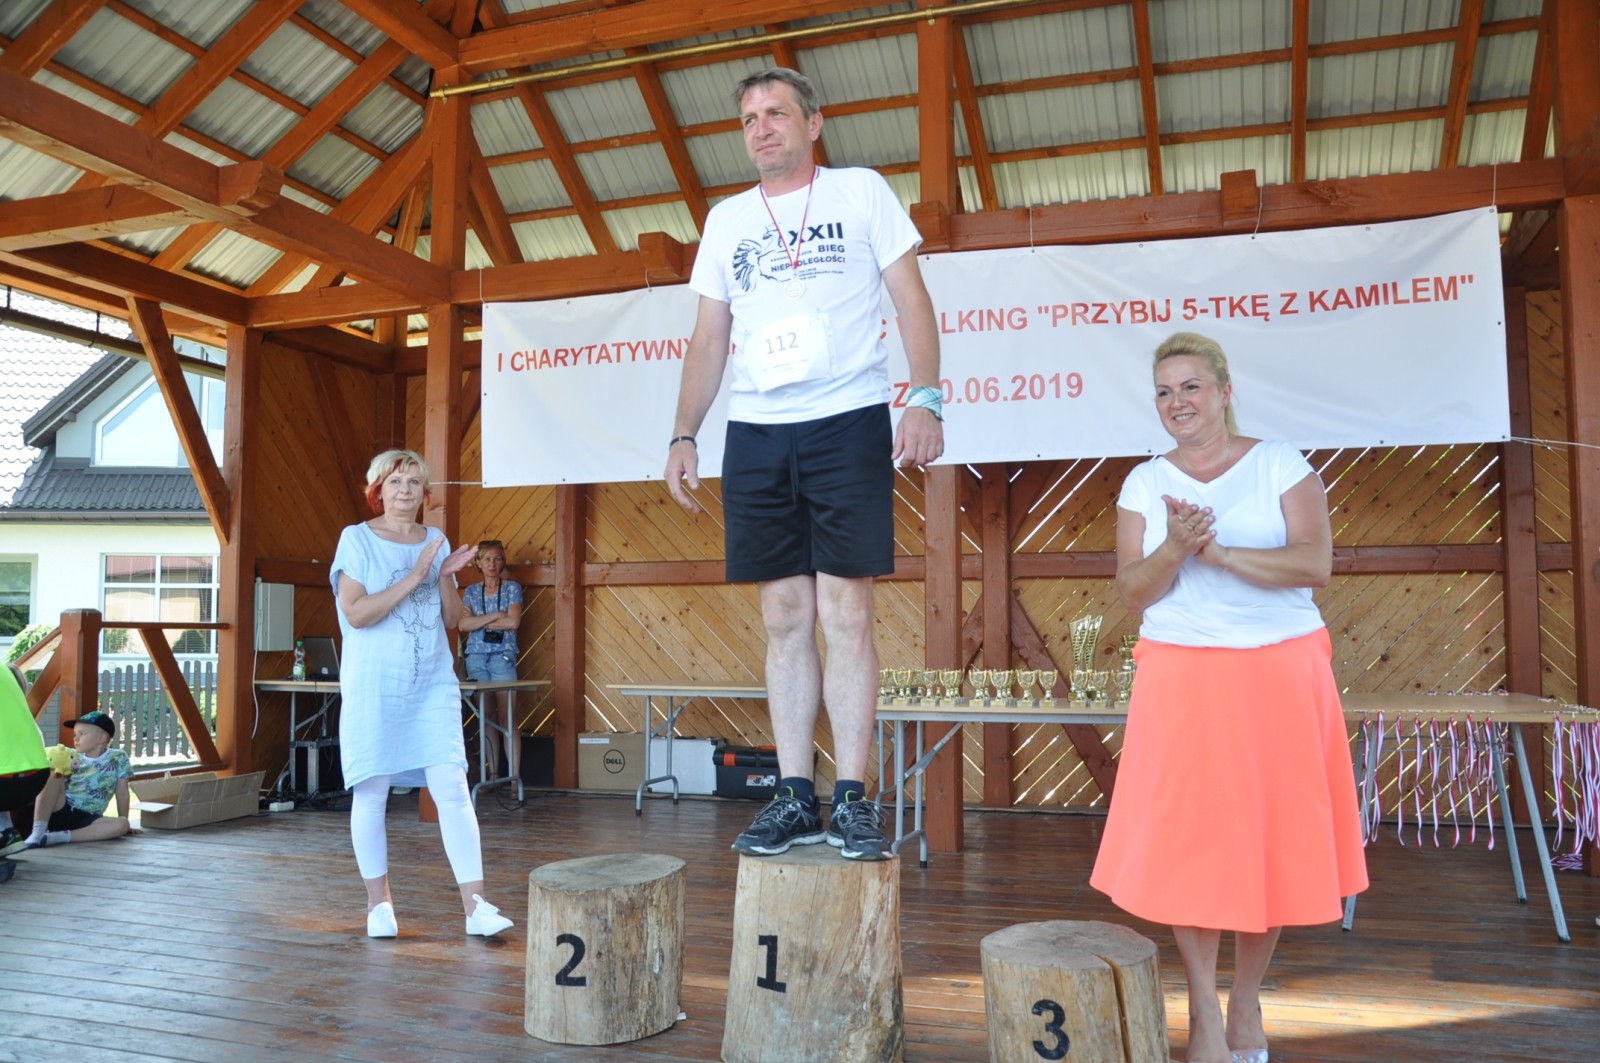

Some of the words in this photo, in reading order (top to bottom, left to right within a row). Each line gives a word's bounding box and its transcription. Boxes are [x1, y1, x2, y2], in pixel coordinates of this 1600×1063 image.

[771, 254, 845, 272] NIEPDLEGŁOŚCI
[818, 244, 845, 252] BIEG
[497, 353, 503, 372] I
[896, 307, 1028, 338] LKING
[1037, 299, 1172, 328] "PRZYBIJ
[1182, 294, 1271, 322] 5-TKĘ
[1279, 292, 1300, 315] Z
[1308, 274, 1475, 312] KAMILEM"
[765, 331, 800, 354] 112
[936, 372, 1084, 405] 0.06.2019
[555, 933, 587, 987] 2
[756, 935, 787, 993] 1
[1032, 999, 1070, 1060] 3
